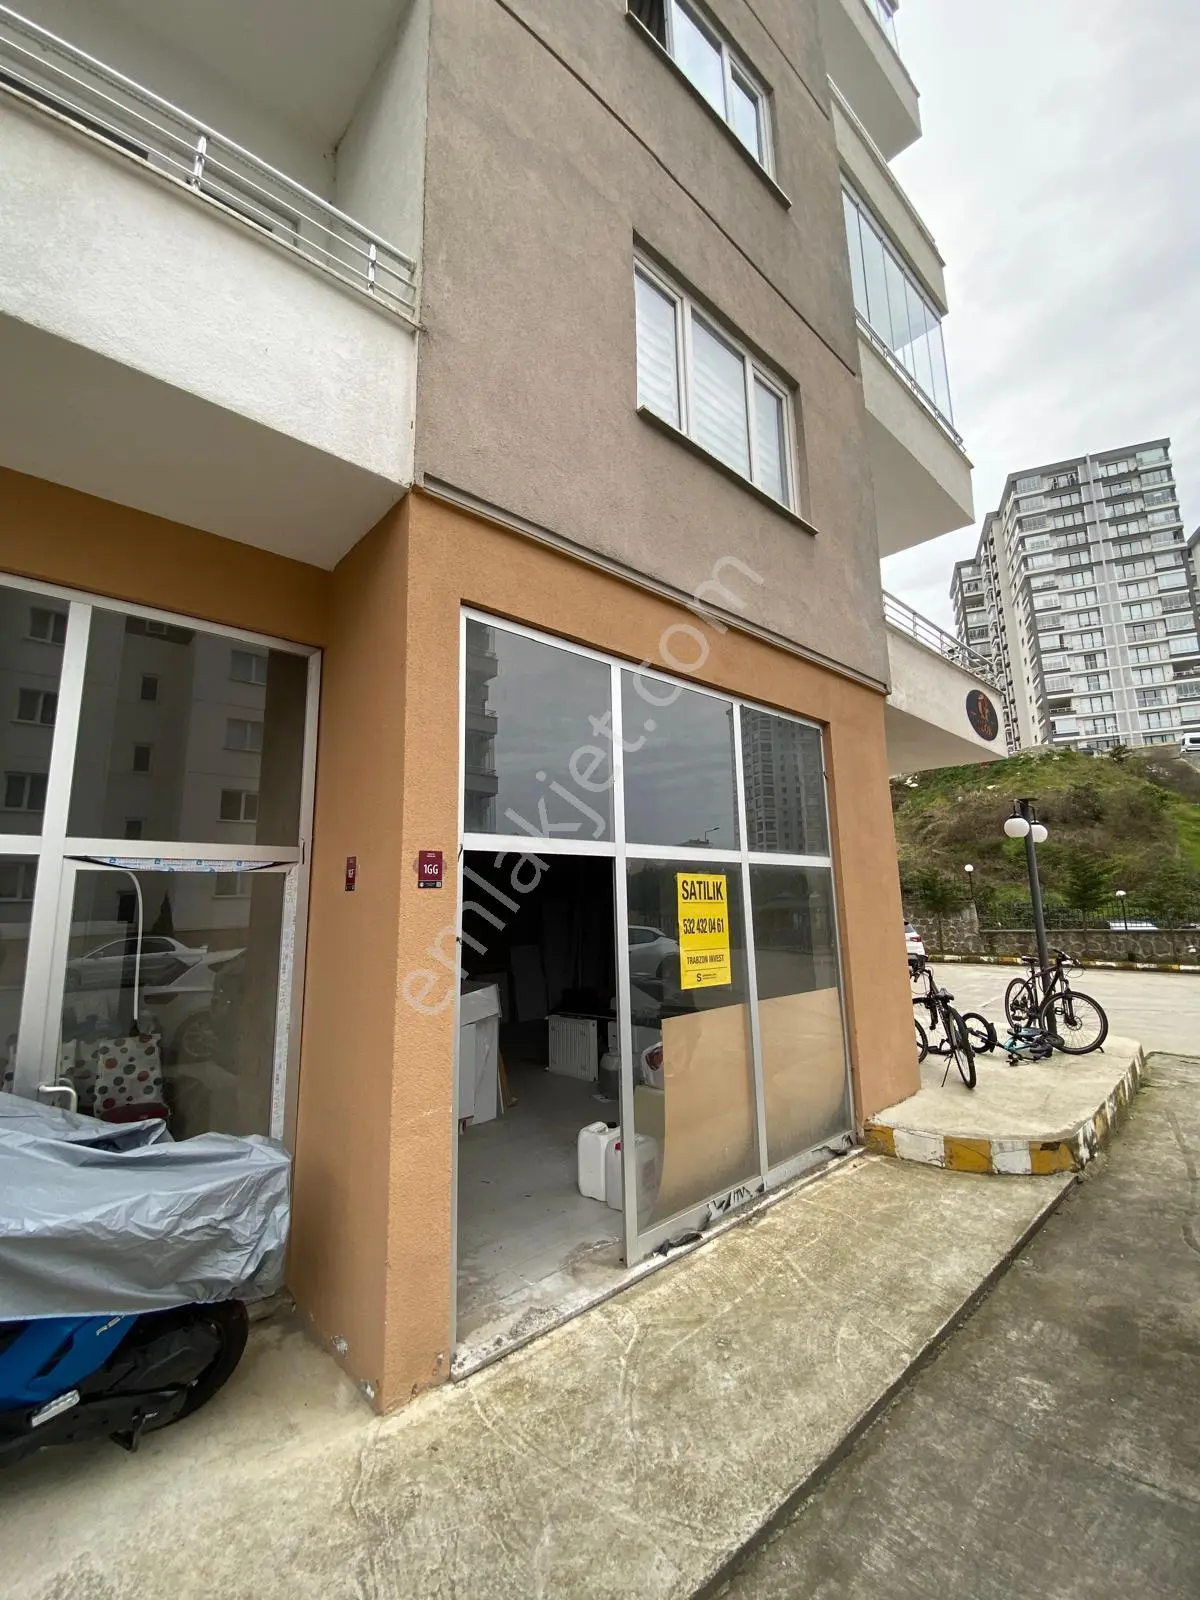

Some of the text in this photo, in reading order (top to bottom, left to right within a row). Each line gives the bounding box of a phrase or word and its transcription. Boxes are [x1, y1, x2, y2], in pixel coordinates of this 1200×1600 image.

[682, 880, 723, 901] SATILIK
[683, 918, 724, 934] 532 432 04 61
[687, 954, 724, 965] TRABZON INVEST
